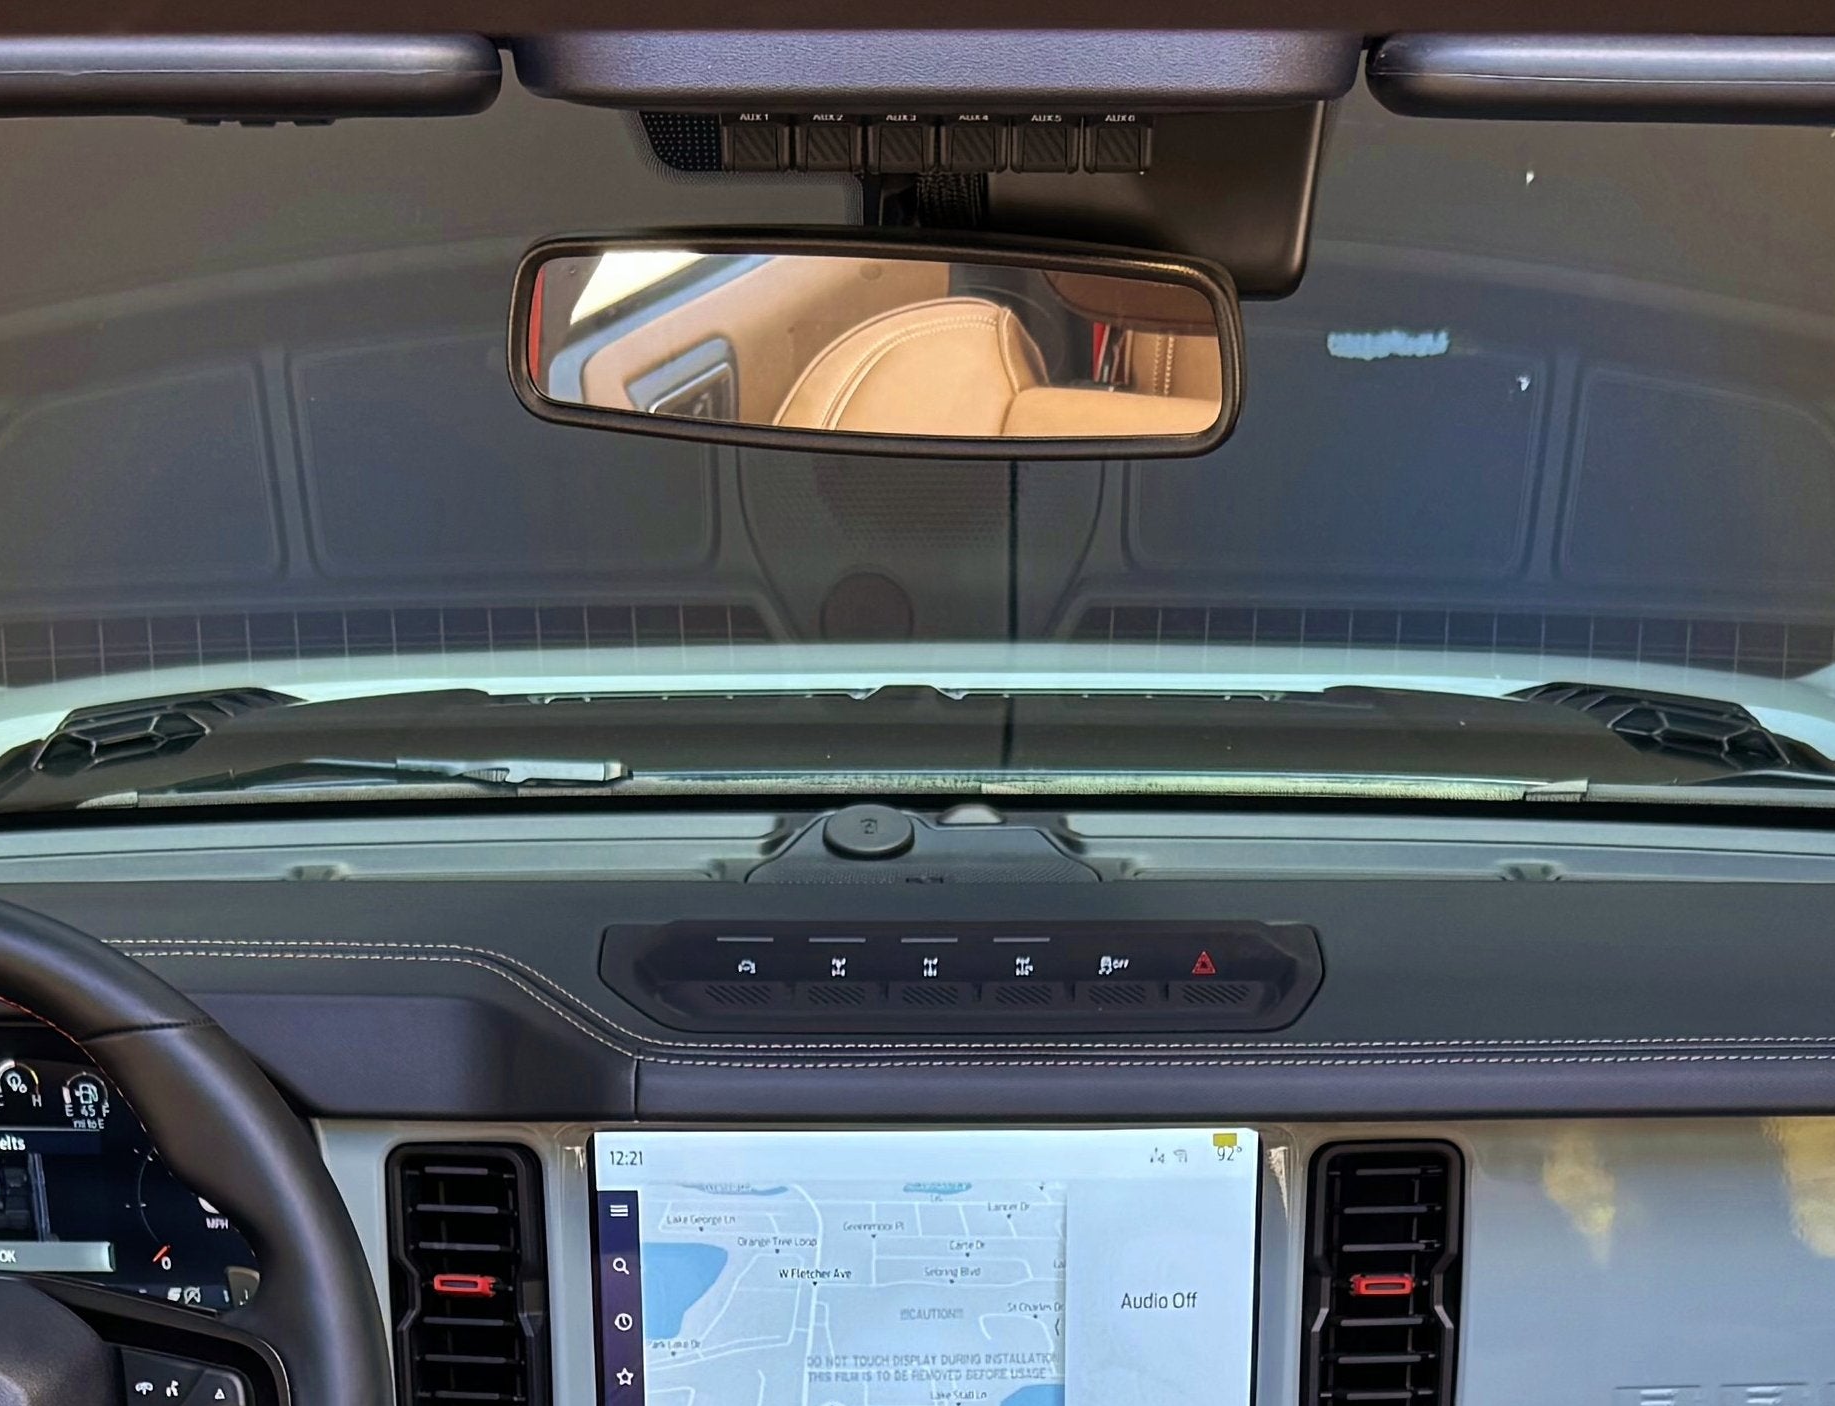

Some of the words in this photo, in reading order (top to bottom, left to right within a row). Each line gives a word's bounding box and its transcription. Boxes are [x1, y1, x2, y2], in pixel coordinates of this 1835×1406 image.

[609, 1150, 644, 1166] 12:21
[205, 1217, 229, 1229] MPH
[666, 1215, 688, 1224] Lake
[161, 1256, 172, 1270] 0
[779, 1268, 789, 1278] W
[791, 1268, 831, 1278] Fletcher
[833, 1269, 852, 1279] Ave
[1120, 1292, 1168, 1309] Audio
[1172, 1291, 1198, 1309] Off
[893, 1355, 936, 1367] DISPLAY
